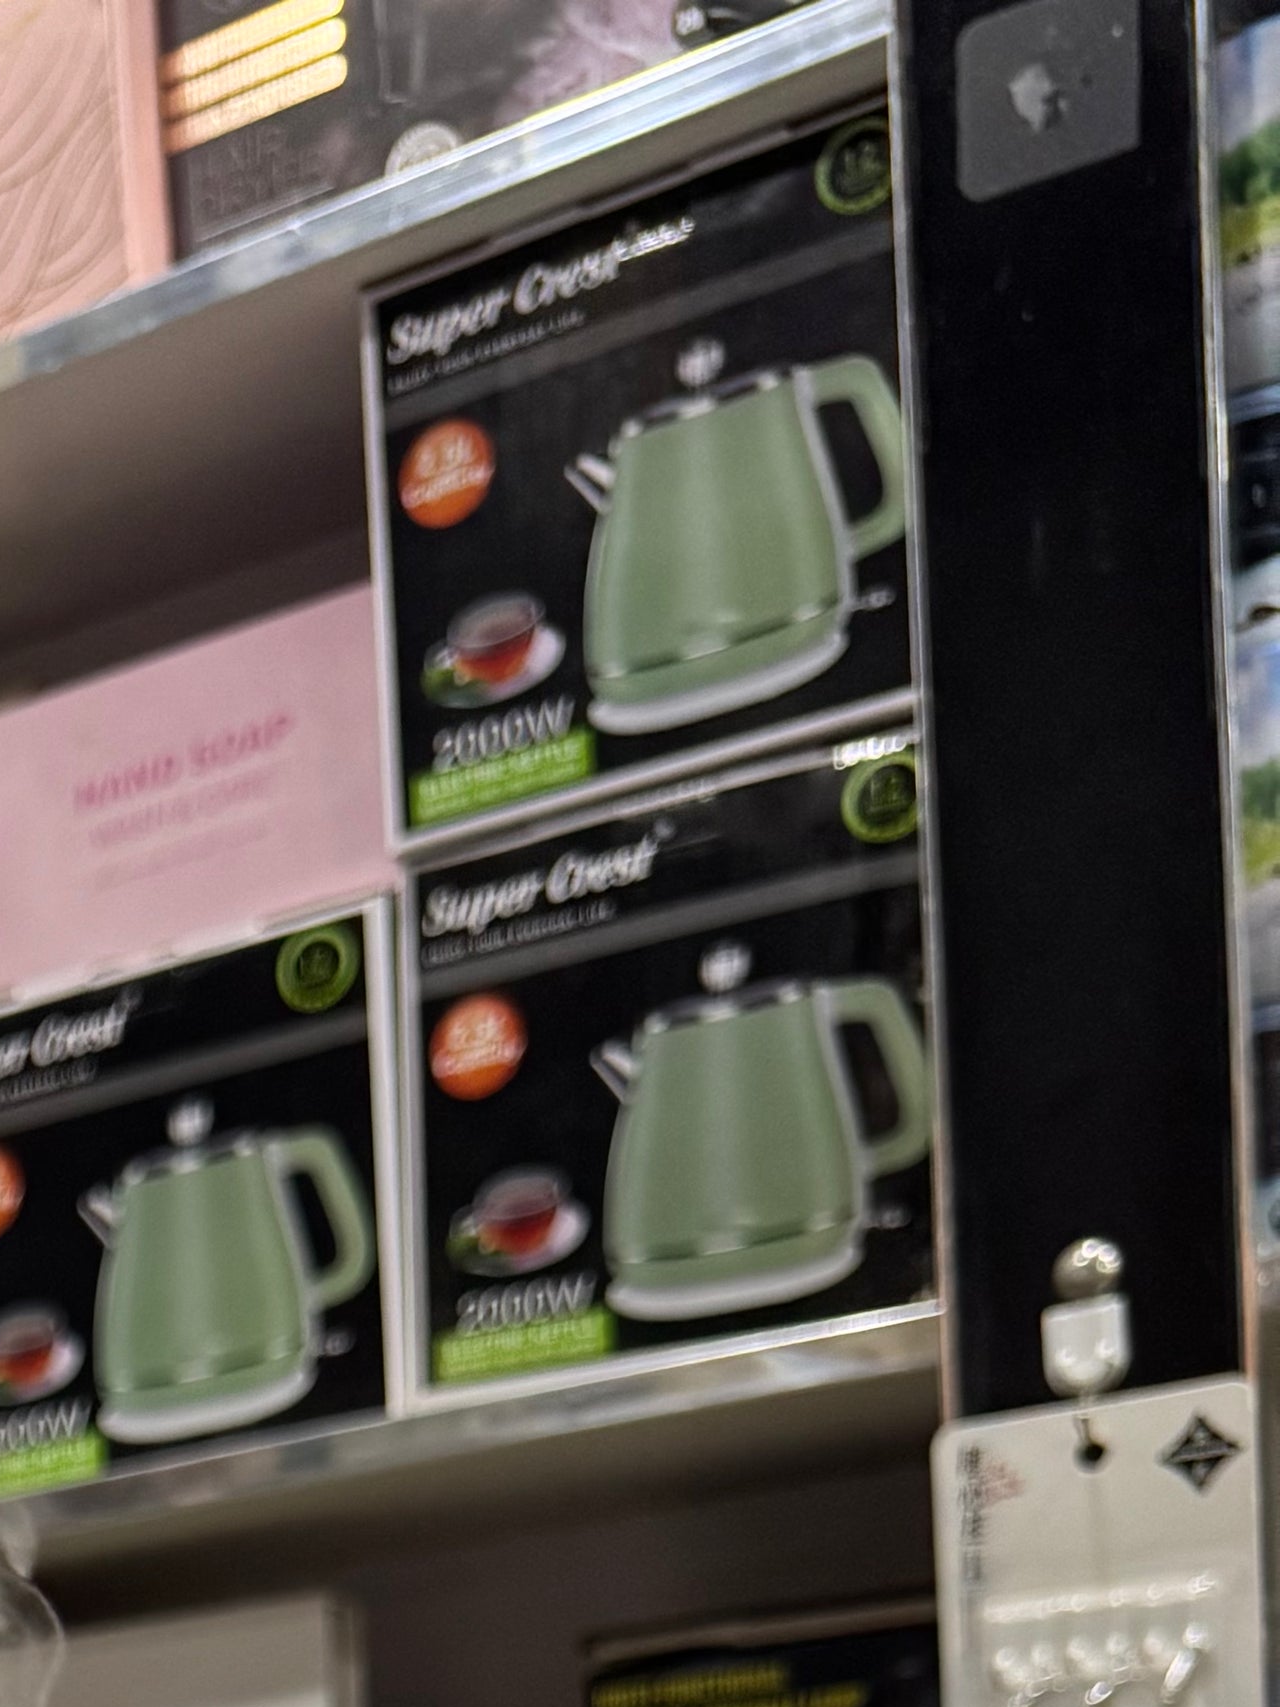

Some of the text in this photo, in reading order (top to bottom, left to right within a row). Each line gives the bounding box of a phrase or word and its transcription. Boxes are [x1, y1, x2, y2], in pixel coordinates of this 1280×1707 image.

[387, 286, 515, 365] Super
[422, 833, 660, 938] Super Crest
[30, 998, 128, 1066] Crest
